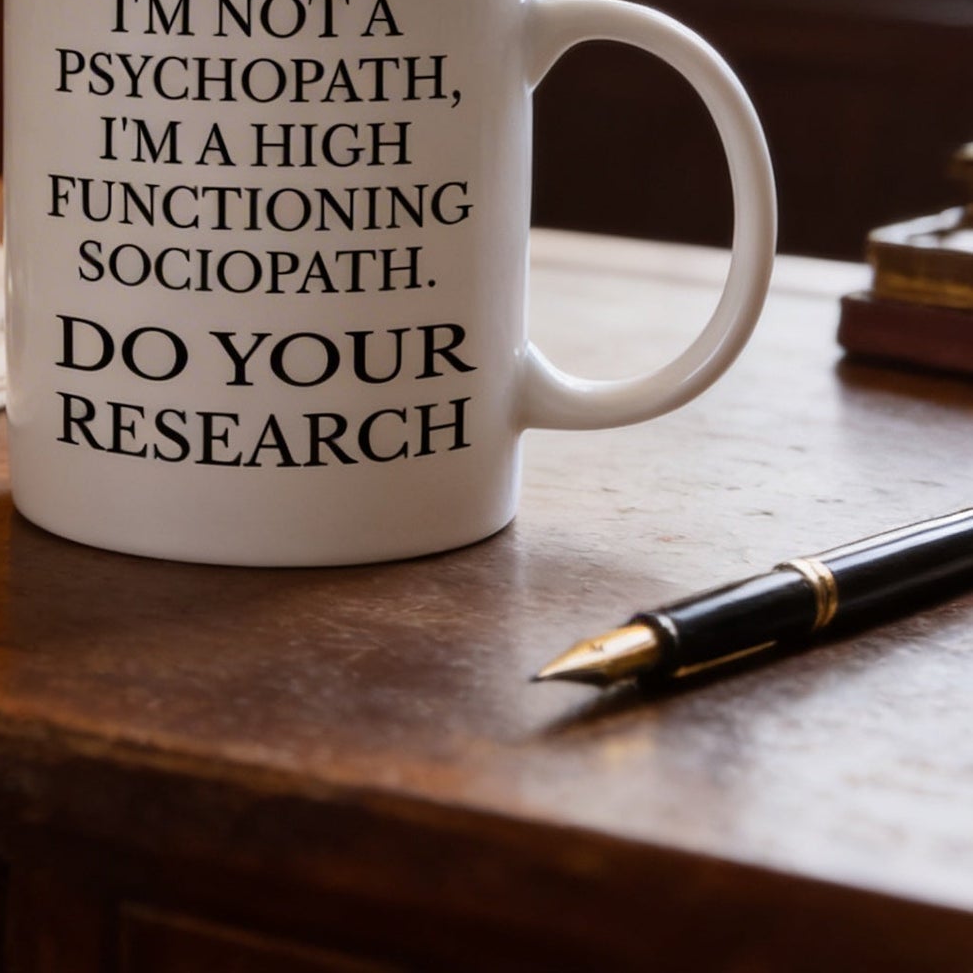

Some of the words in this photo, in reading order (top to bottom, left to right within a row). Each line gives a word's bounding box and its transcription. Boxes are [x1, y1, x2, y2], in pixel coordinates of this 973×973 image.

[54, 47, 463, 110] PSYCHOPATH,
[99, 115, 183, 165] I'M
[194, 122, 237, 167] A
[249, 120, 414, 169] HIGH
[47, 173, 475, 233] FUNCTIONING
[78, 239, 438, 295] SOCIOPATH.
[54, 314, 189, 383] DO
[208, 322, 479, 388] YOUR
[55, 391, 473, 469] RESEARCH
